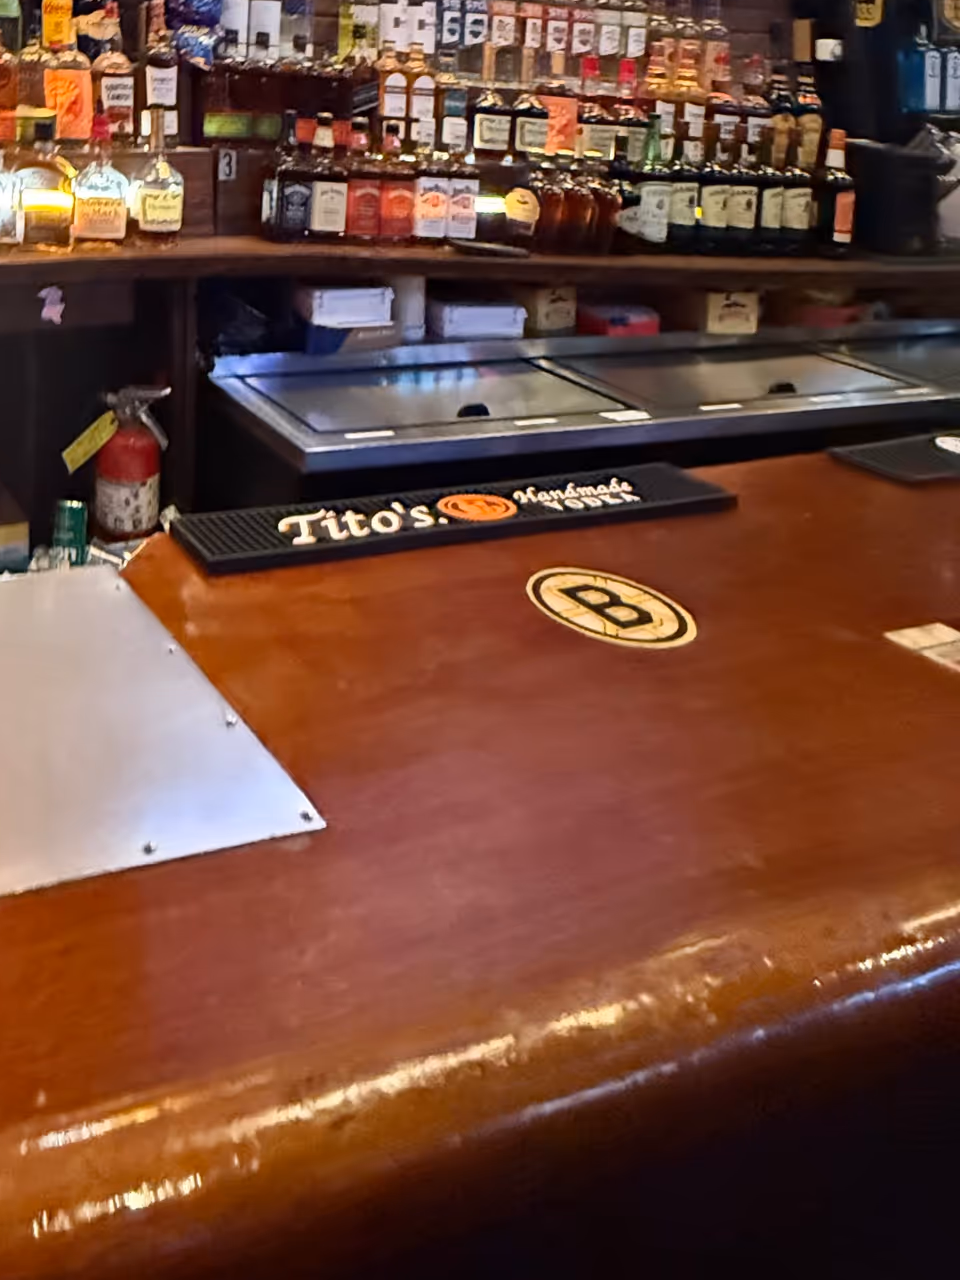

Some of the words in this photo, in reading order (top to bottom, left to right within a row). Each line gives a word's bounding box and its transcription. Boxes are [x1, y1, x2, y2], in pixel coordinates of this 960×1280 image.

[222, 153, 233, 177] 3
[513, 477, 632, 504] Handmade
[543, 491, 641, 512] VODKA
[557, 584, 654, 629] B
